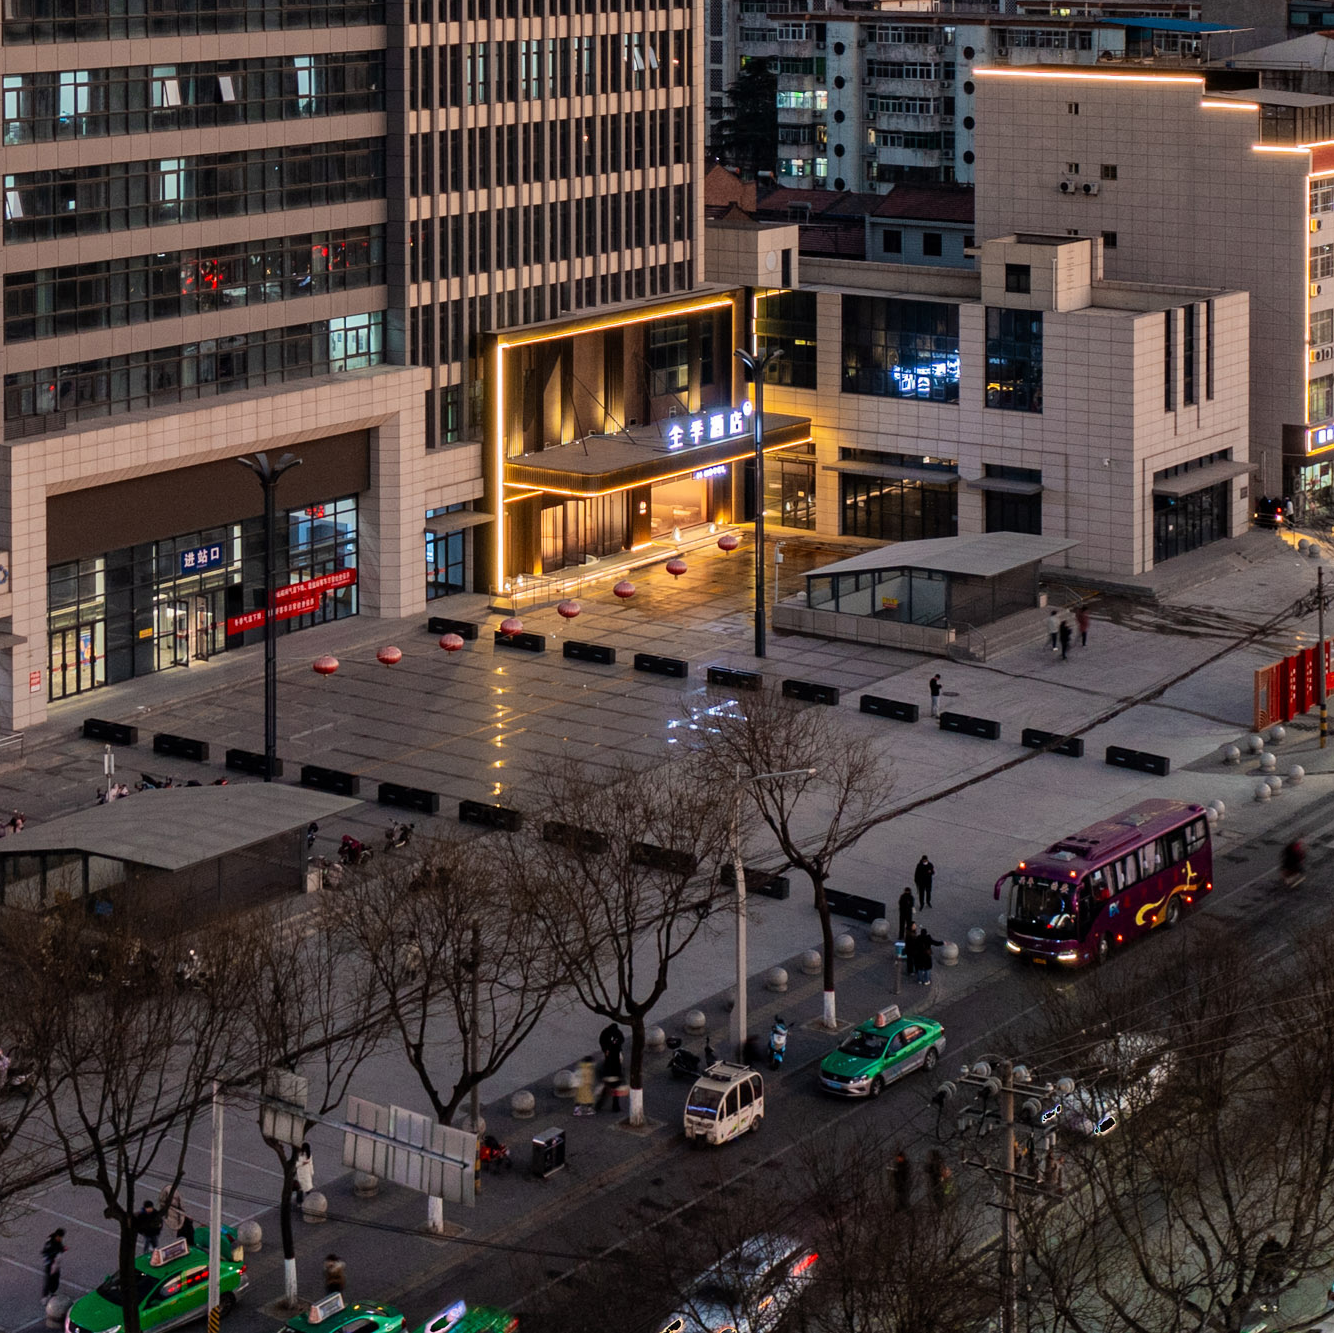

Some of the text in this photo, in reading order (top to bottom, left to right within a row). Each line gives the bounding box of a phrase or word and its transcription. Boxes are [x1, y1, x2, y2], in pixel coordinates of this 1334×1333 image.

[668, 411, 743, 450] 全季酒店
[184, 547, 220, 568] 进站口
